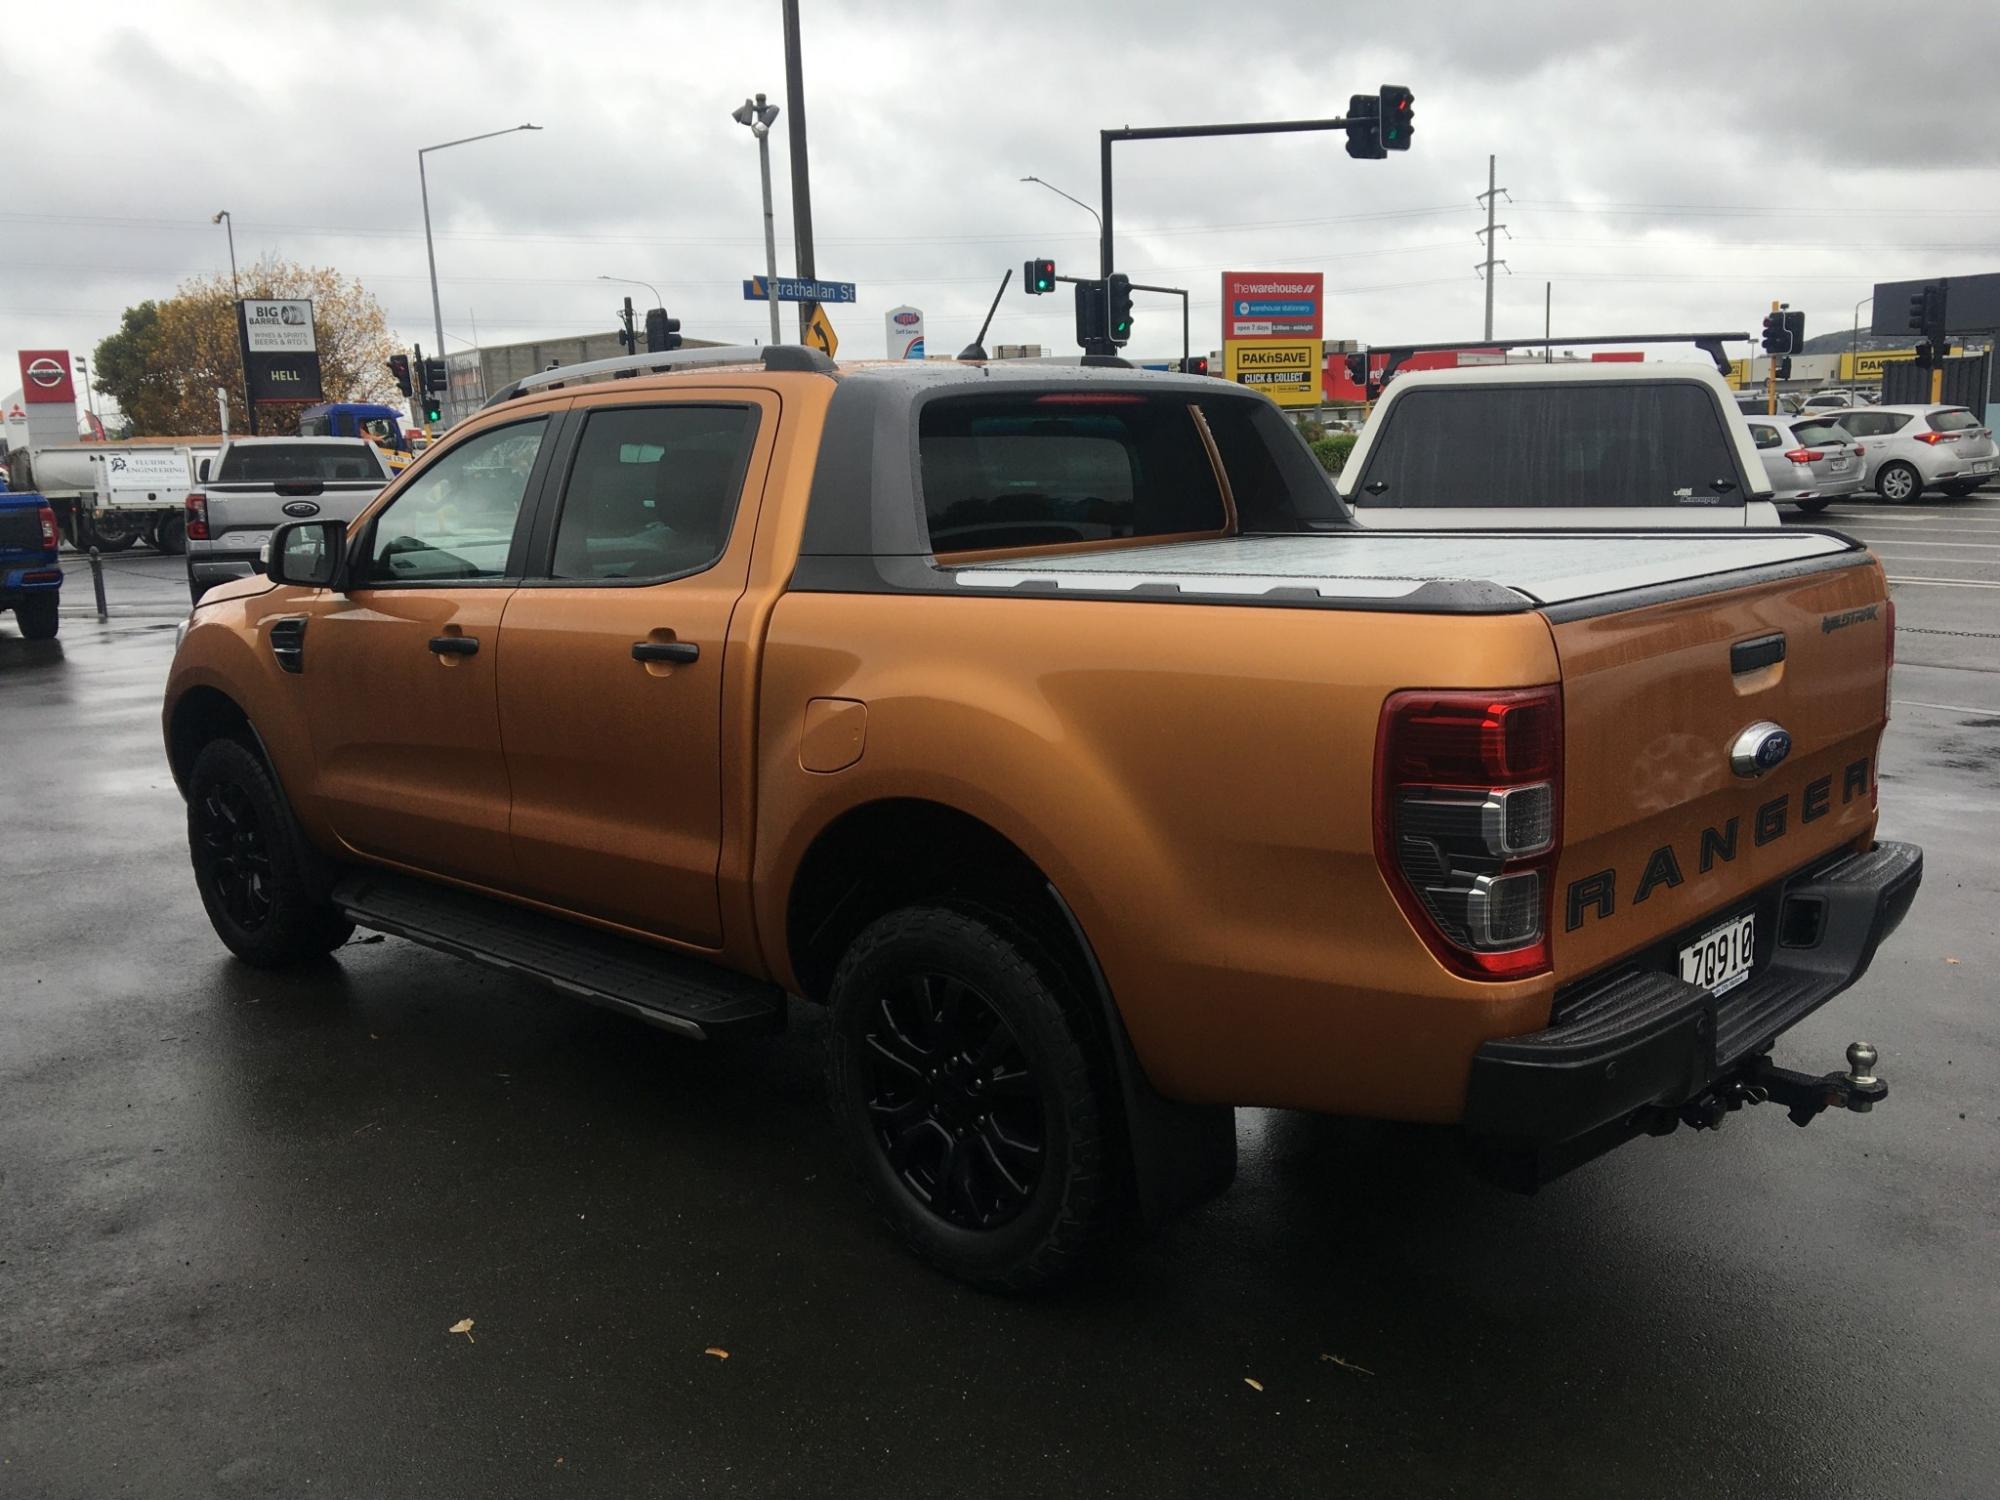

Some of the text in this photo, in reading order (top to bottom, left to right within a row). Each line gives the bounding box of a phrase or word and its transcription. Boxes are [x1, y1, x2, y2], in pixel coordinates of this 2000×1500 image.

[767, 281, 854, 301] trathallan St
[255, 306, 278, 318] BIG
[1250, 303, 1310, 313] warehouse stationery
[249, 317, 281, 325] BARREL
[1257, 325, 1269, 333] days
[271, 370, 300, 381] HELL
[1244, 372, 1304, 384] CLICK & COLLECT
[1566, 757, 1869, 933] RANGER
